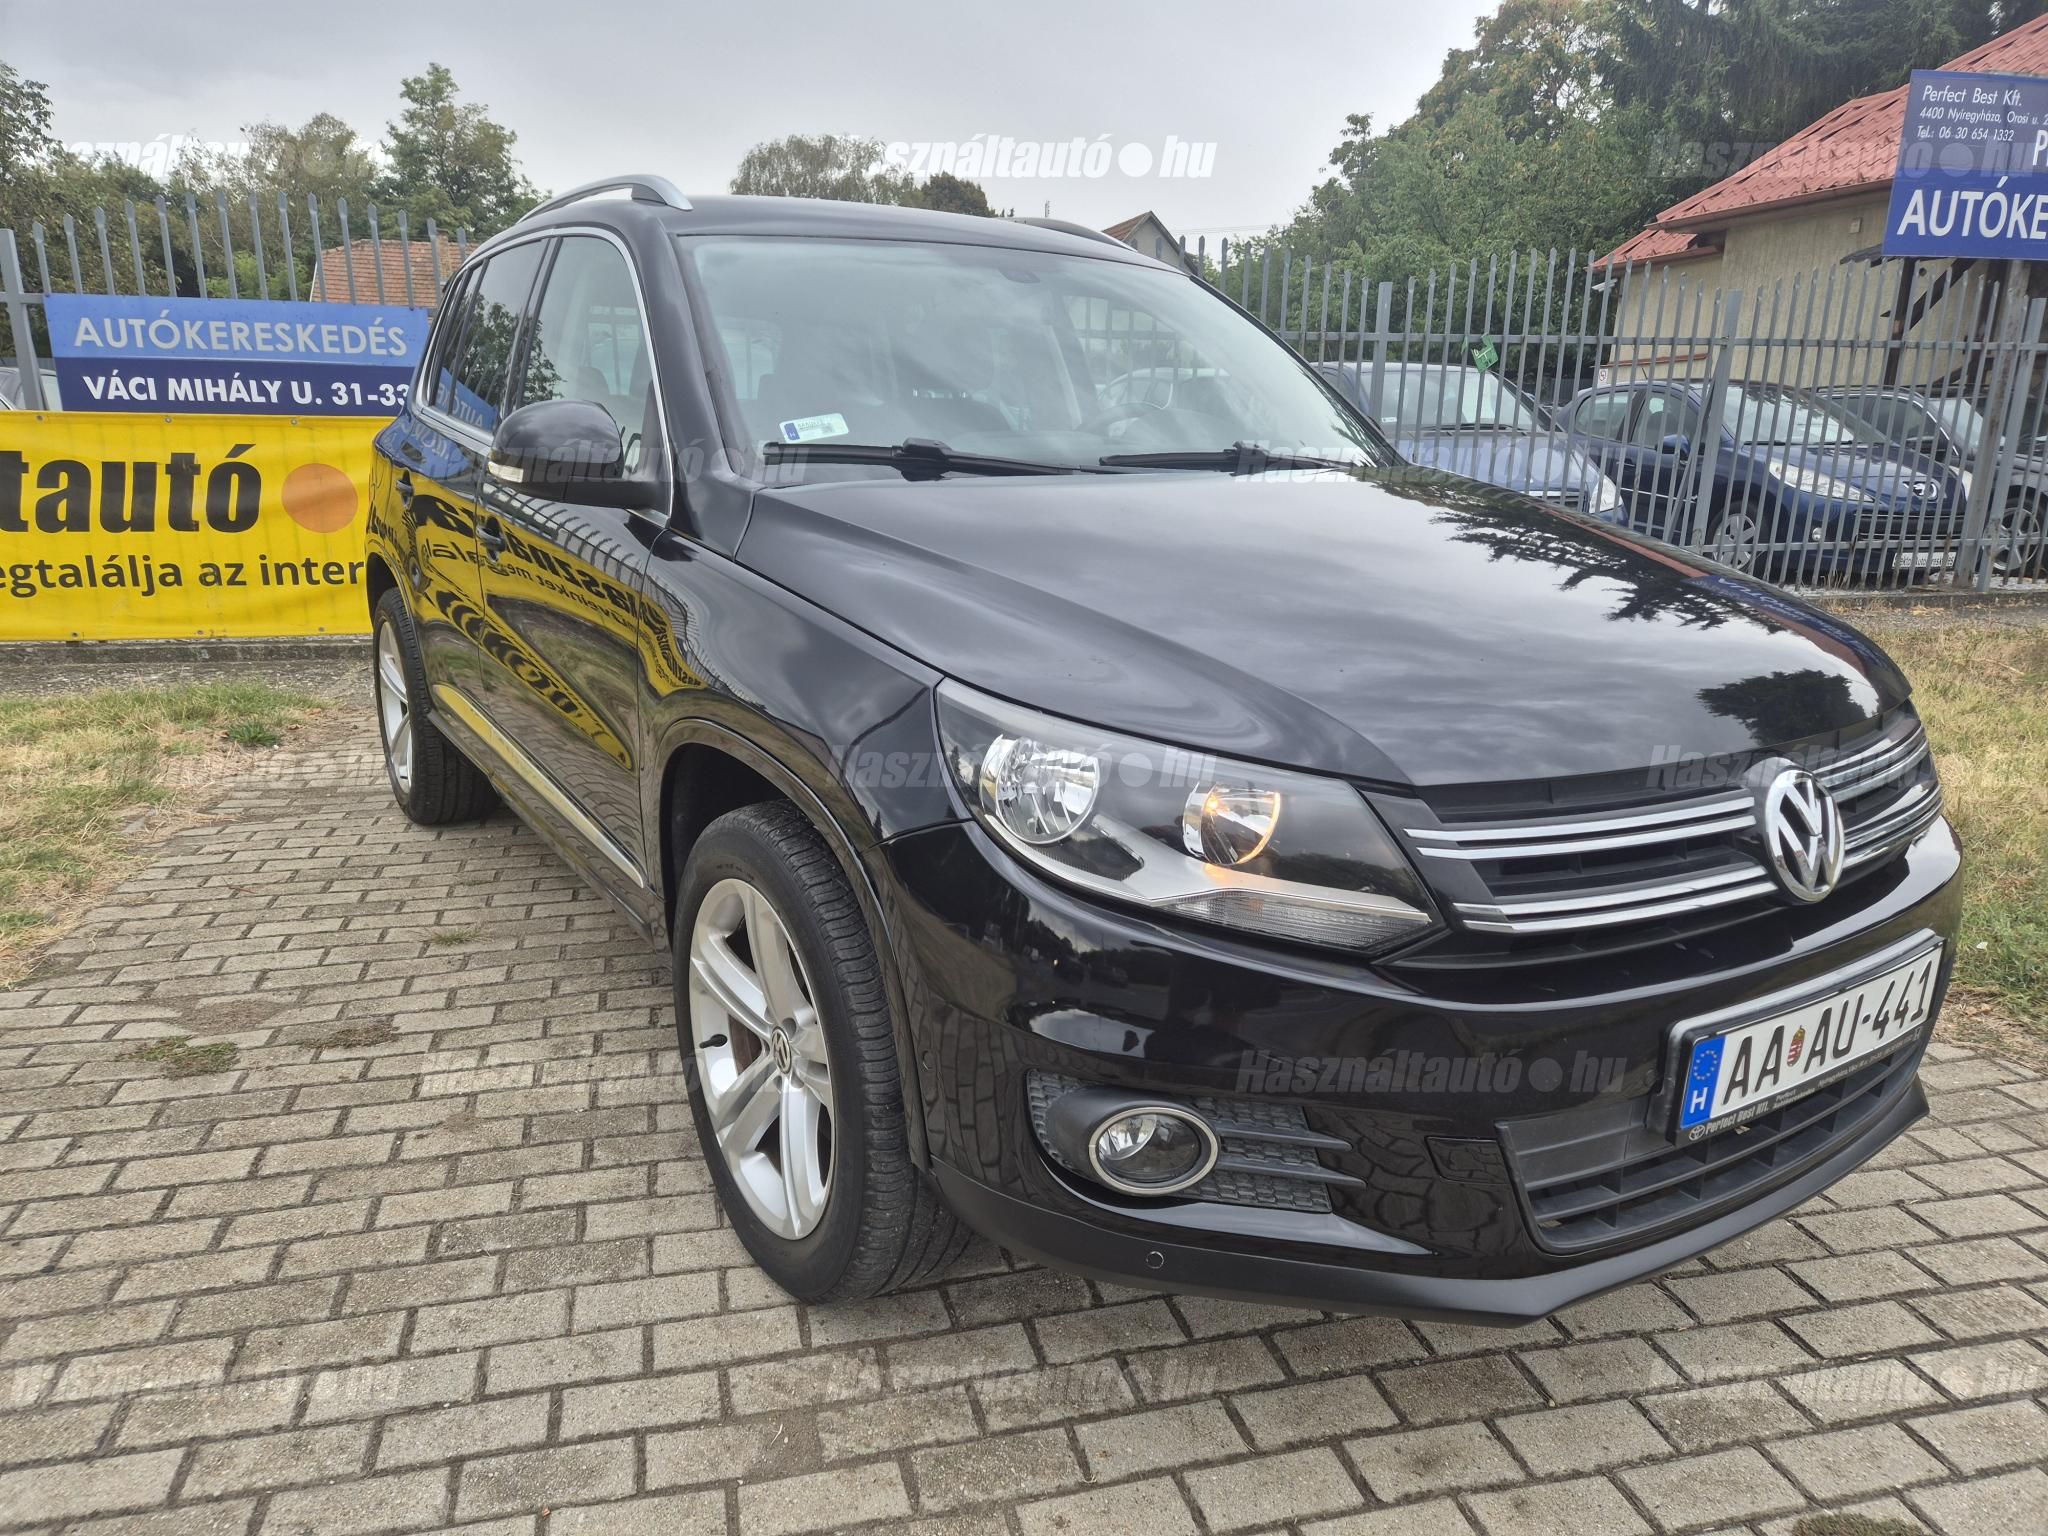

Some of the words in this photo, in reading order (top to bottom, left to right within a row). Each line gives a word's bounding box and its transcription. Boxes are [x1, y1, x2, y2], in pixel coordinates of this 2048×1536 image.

[1919, 106, 1945, 119] 4400
[1922, 85, 1967, 103] Perfect
[1972, 87, 1998, 105] Best
[2003, 89, 2022, 106] Kft.
[1916, 125, 1934, 138] Tel.:
[1939, 126, 1951, 139] 06
[1954, 127, 1968, 140] 30
[1971, 127, 1989, 140] 654
[1993, 128, 2015, 142] 1332
[1896, 175, 2048, 240] AUTÓKE
[74, 309, 408, 357] AUTÓKERESKEDÉS
[83, 369, 157, 401] VÁCI
[167, 371, 286, 404] MIHÁLY
[291, 381, 323, 406] U.
[0, 554, 183, 598] gtalálja
[199, 562, 248, 588] az
[259, 553, 365, 587] inter
[1722, 1025, 1786, 1105] AA
[1803, 960, 1932, 1074] AU-441
[1690, 1086, 1708, 1114] H
